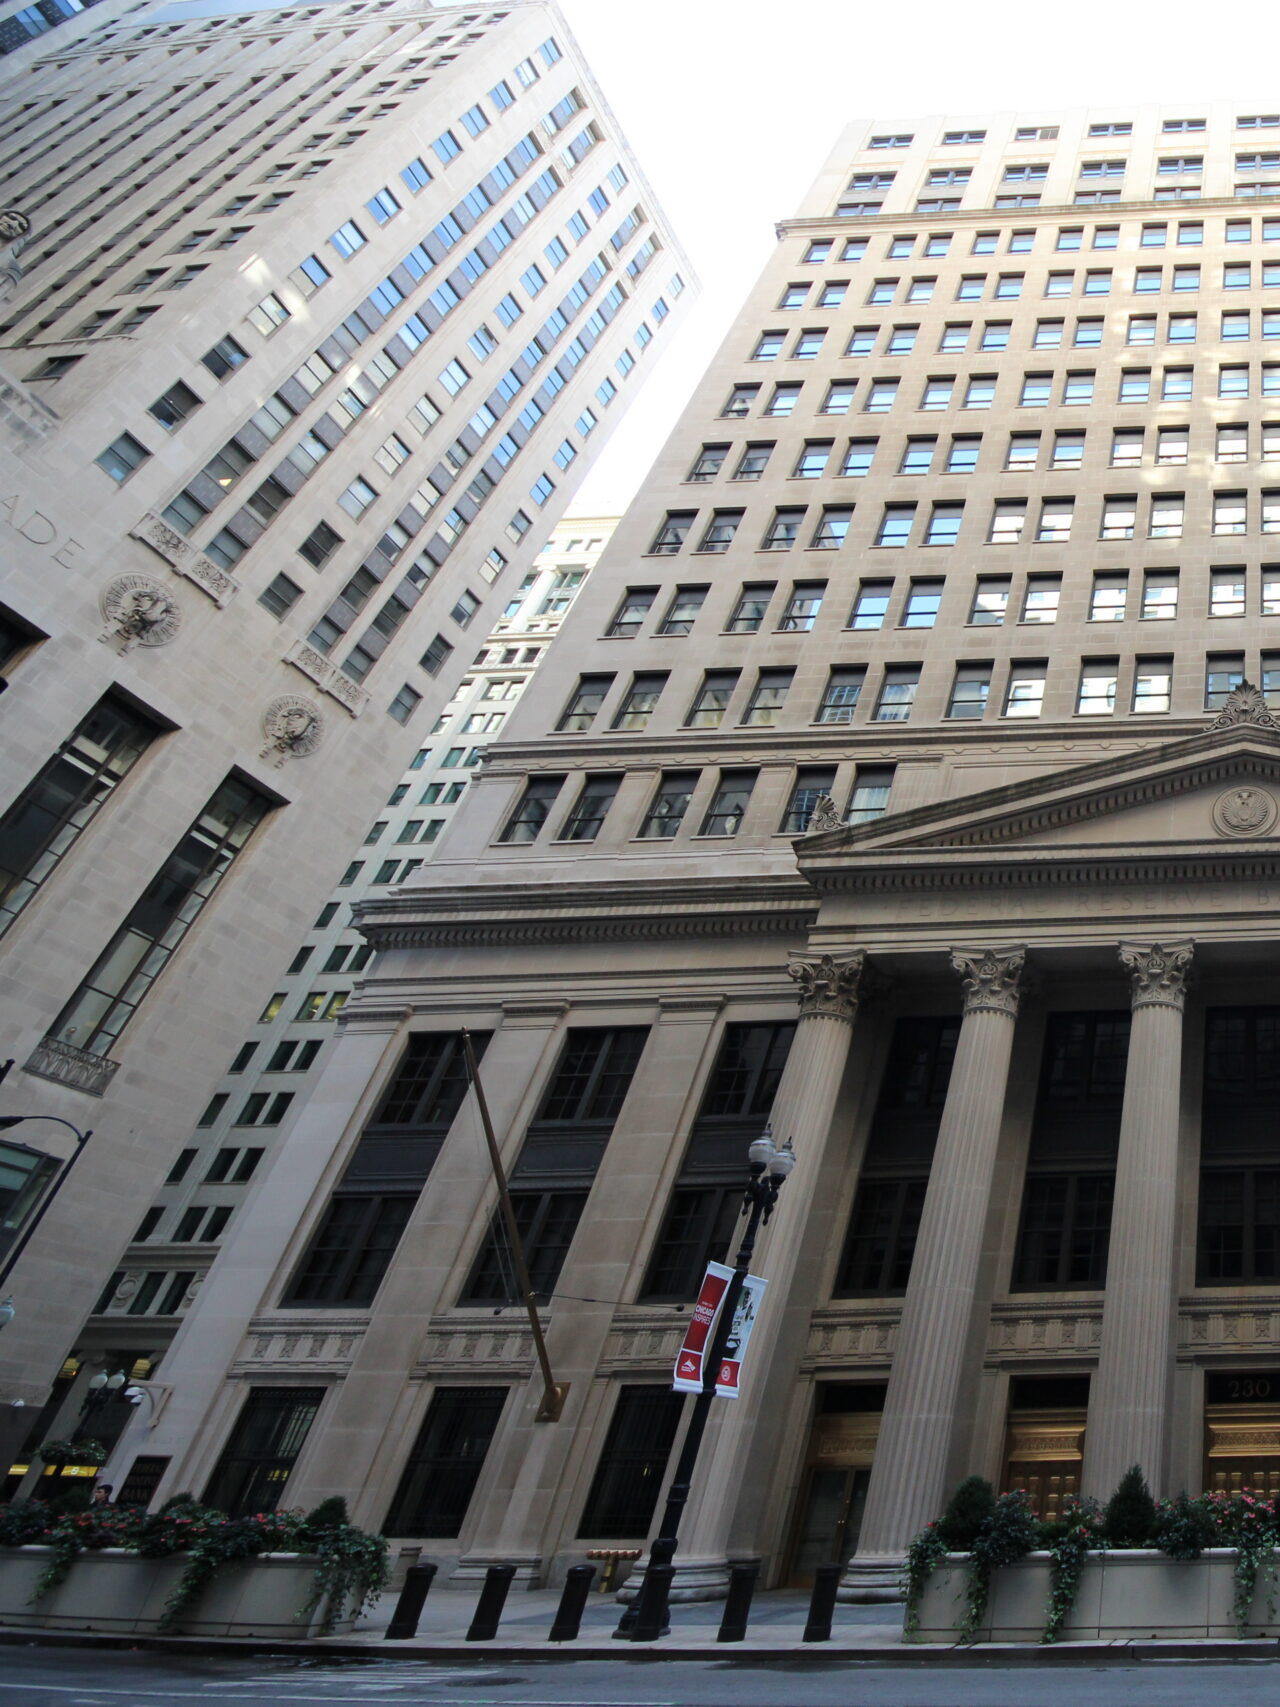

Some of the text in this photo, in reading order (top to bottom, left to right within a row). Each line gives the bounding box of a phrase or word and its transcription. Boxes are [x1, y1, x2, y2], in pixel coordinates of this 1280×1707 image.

[896, 894, 1049, 918] FEDERAL
[1075, 887, 1224, 911] RESERVE
[695, 1304, 715, 1317] CHICAGO
[692, 1313, 712, 1326] INSPIRES
[1228, 1379, 1271, 1398] 230
